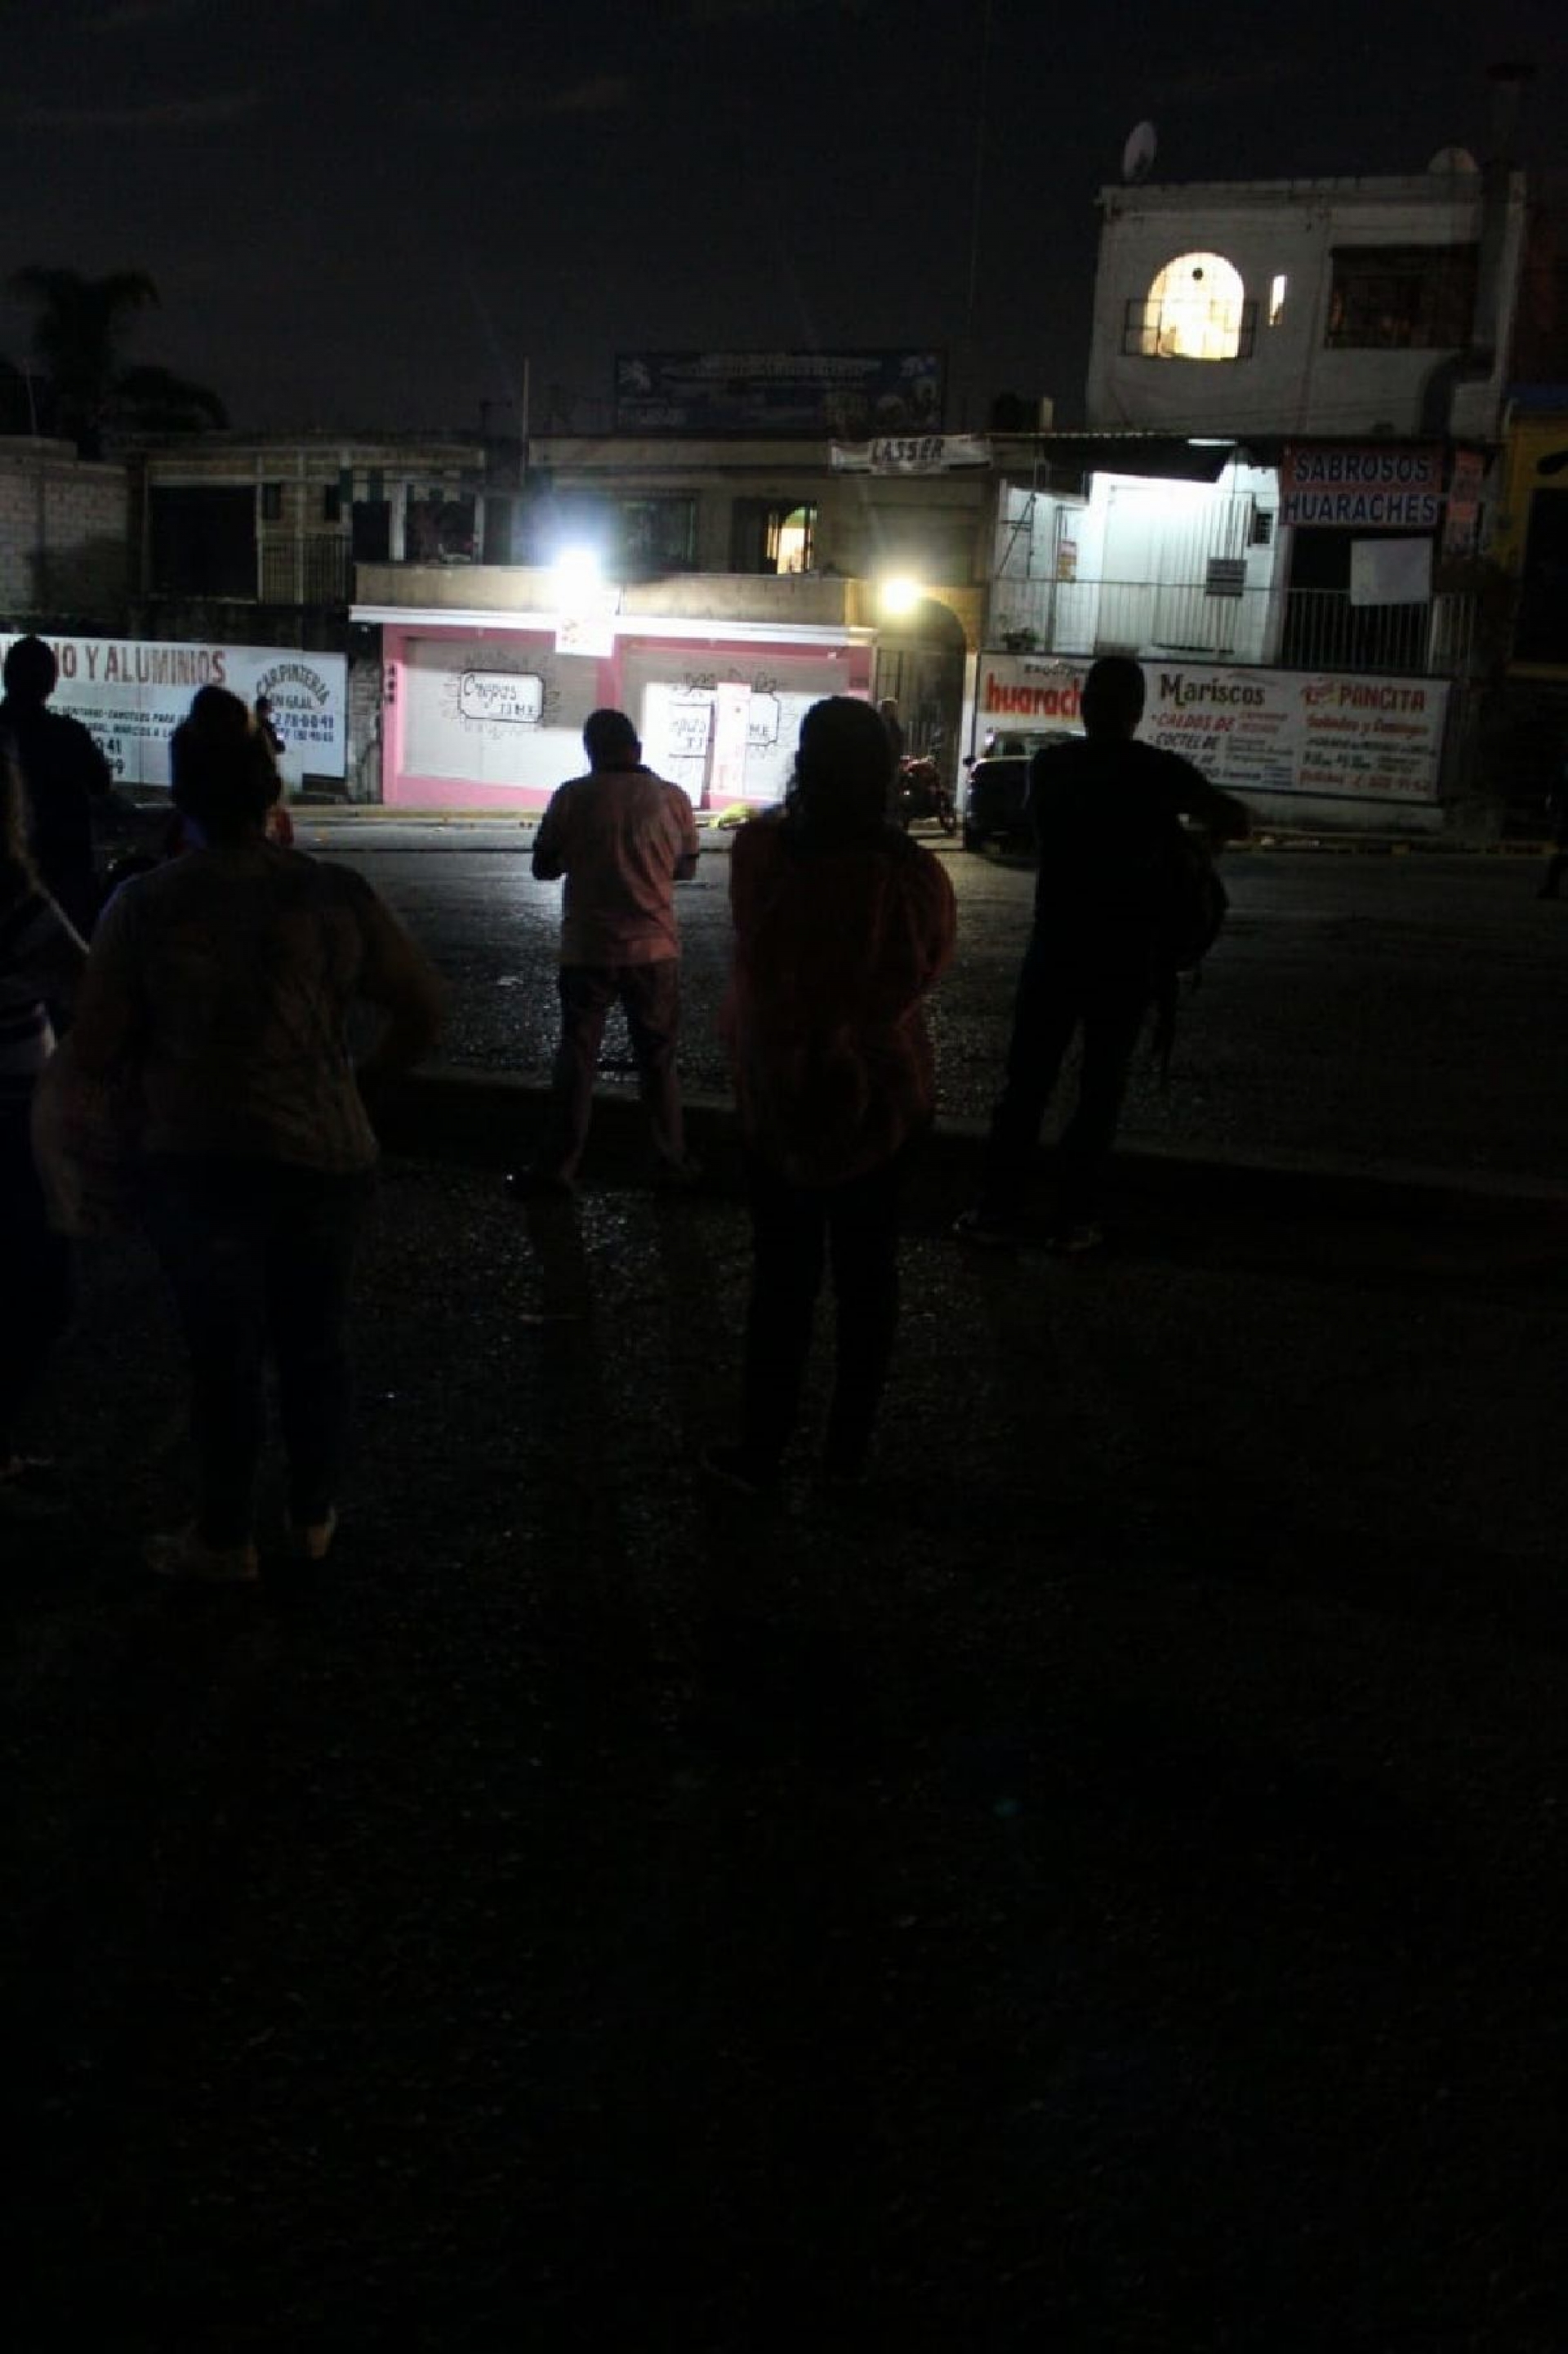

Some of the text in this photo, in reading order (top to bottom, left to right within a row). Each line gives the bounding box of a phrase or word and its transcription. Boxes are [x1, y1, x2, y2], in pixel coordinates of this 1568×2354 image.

[1296, 453, 1429, 482] SABROSOS
[1284, 493, 1435, 524] HUARACHES
[86, 645, 99, 680] Y
[1160, 673, 1265, 707] Mariscos
[1339, 684, 1426, 713] PANCITA
